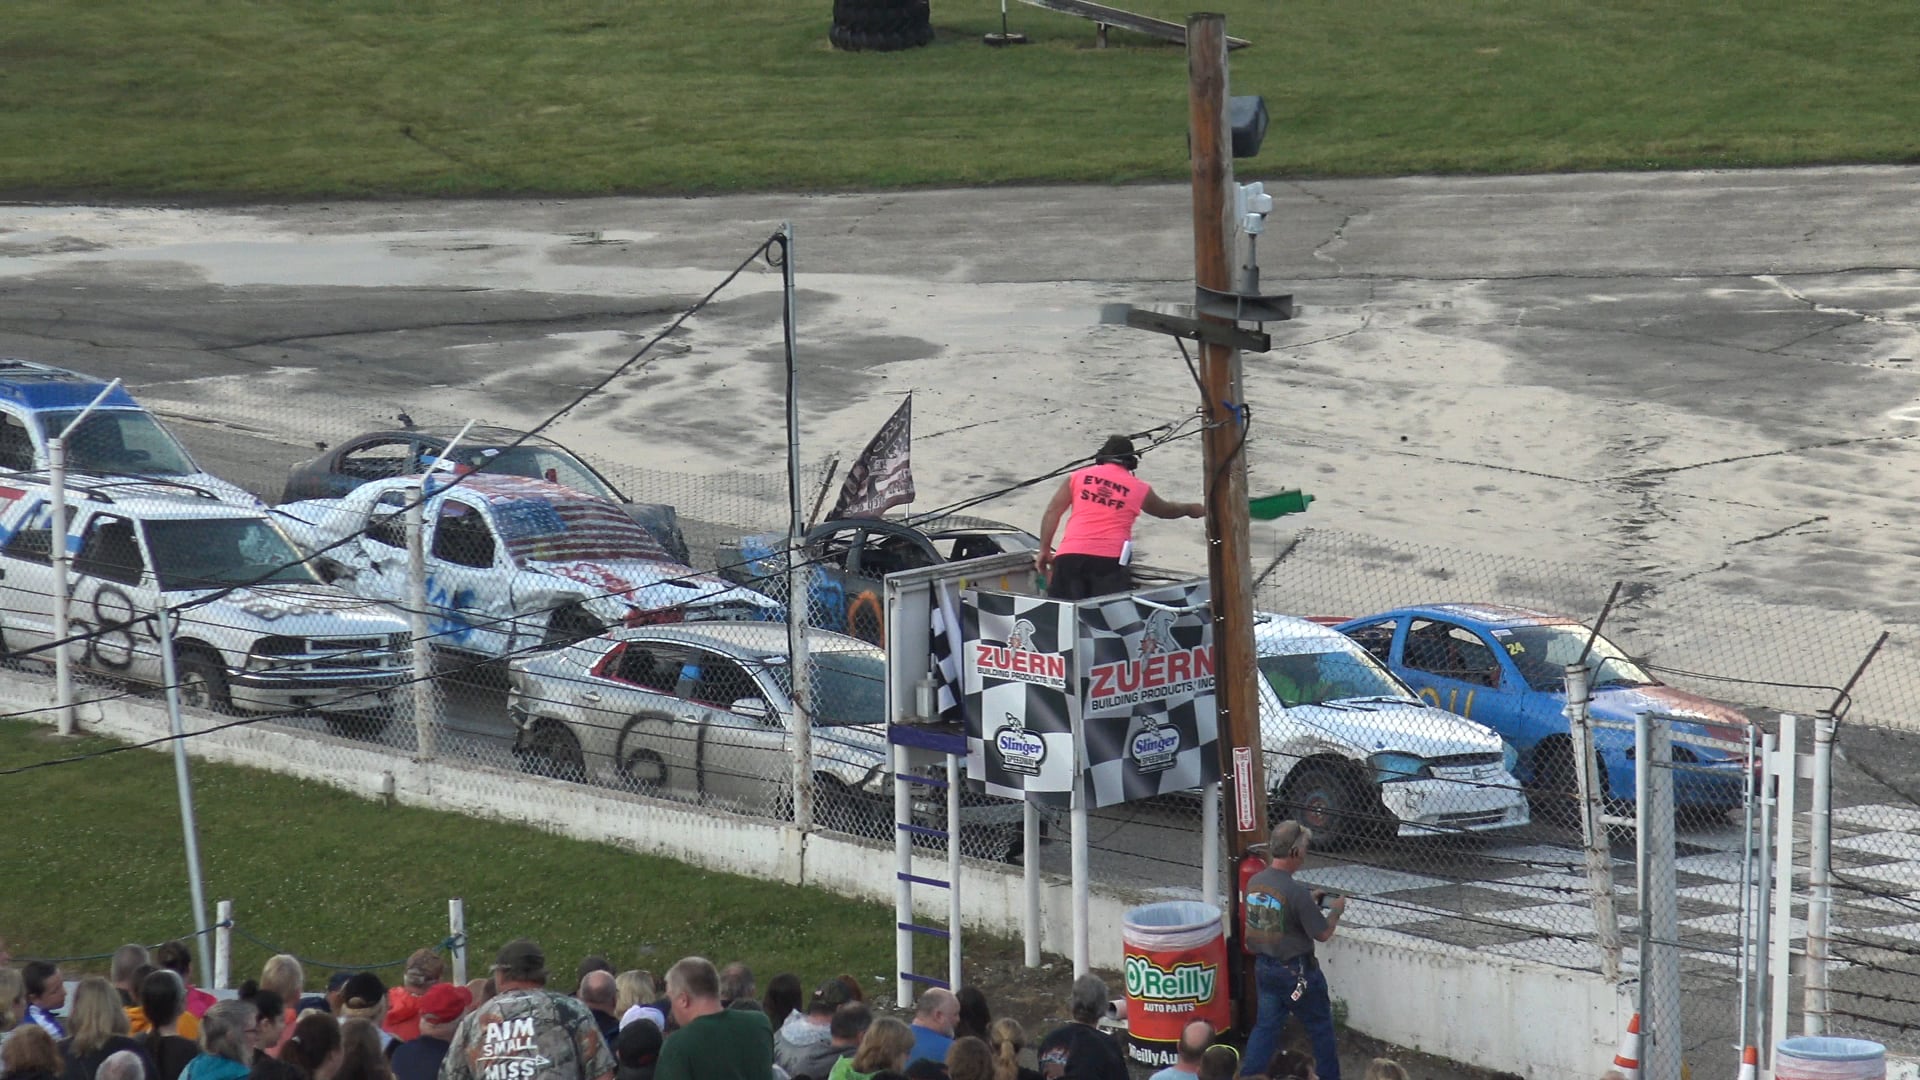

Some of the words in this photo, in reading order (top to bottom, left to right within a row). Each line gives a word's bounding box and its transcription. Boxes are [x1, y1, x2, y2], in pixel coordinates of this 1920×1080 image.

[1083, 474, 1131, 497] EVENT
[1080, 488, 1125, 510] STAFF
[1506, 641, 1525, 656] 24
[976, 645, 1065, 679] ZUERN
[977, 666, 1010, 678] BUILDING
[1090, 646, 1216, 699] ZUERN
[1092, 692, 1139, 710] BUILDING
[615, 708, 713, 793] 61
[1000, 735, 1042, 755] Slinger
[1135, 736, 1178, 754] Slinger
[1125, 958, 1216, 1001] O'Reilly
[1144, 1002, 1165, 1012] AUTO
[1166, 1002, 1195, 1012] PARTS
[486, 1017, 535, 1044] AIM
[483, 1037, 538, 1057] SMALL
[485, 1060, 535, 1080] MISS
